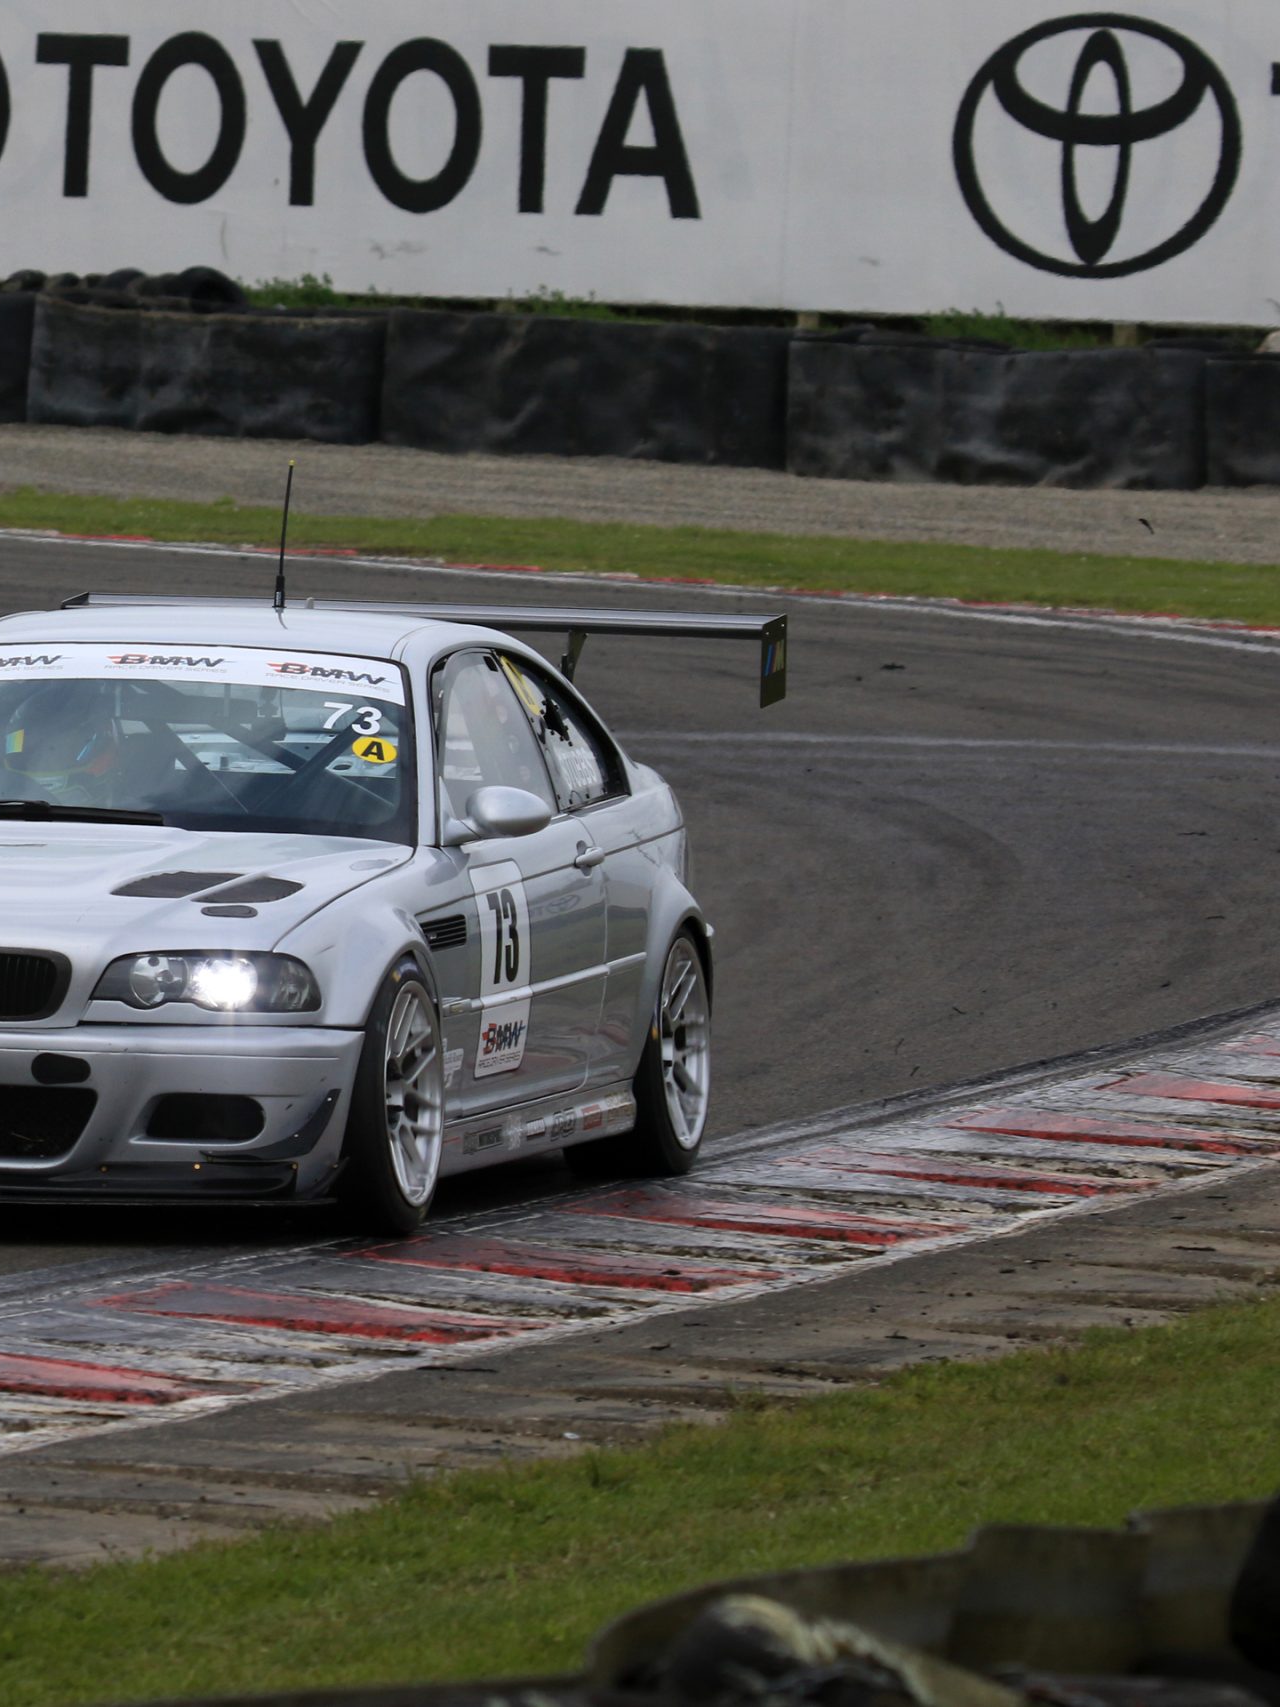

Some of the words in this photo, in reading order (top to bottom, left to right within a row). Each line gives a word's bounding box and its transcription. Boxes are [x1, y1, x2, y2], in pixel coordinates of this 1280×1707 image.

[36, 31, 702, 220] TOYOTA
[107, 653, 224, 667] BMW
[267, 662, 386, 685] BMW
[323, 701, 383, 735] 73
[360, 741, 385, 761] A
[486, 888, 520, 984] 73
[482, 1020, 526, 1056] BMW
